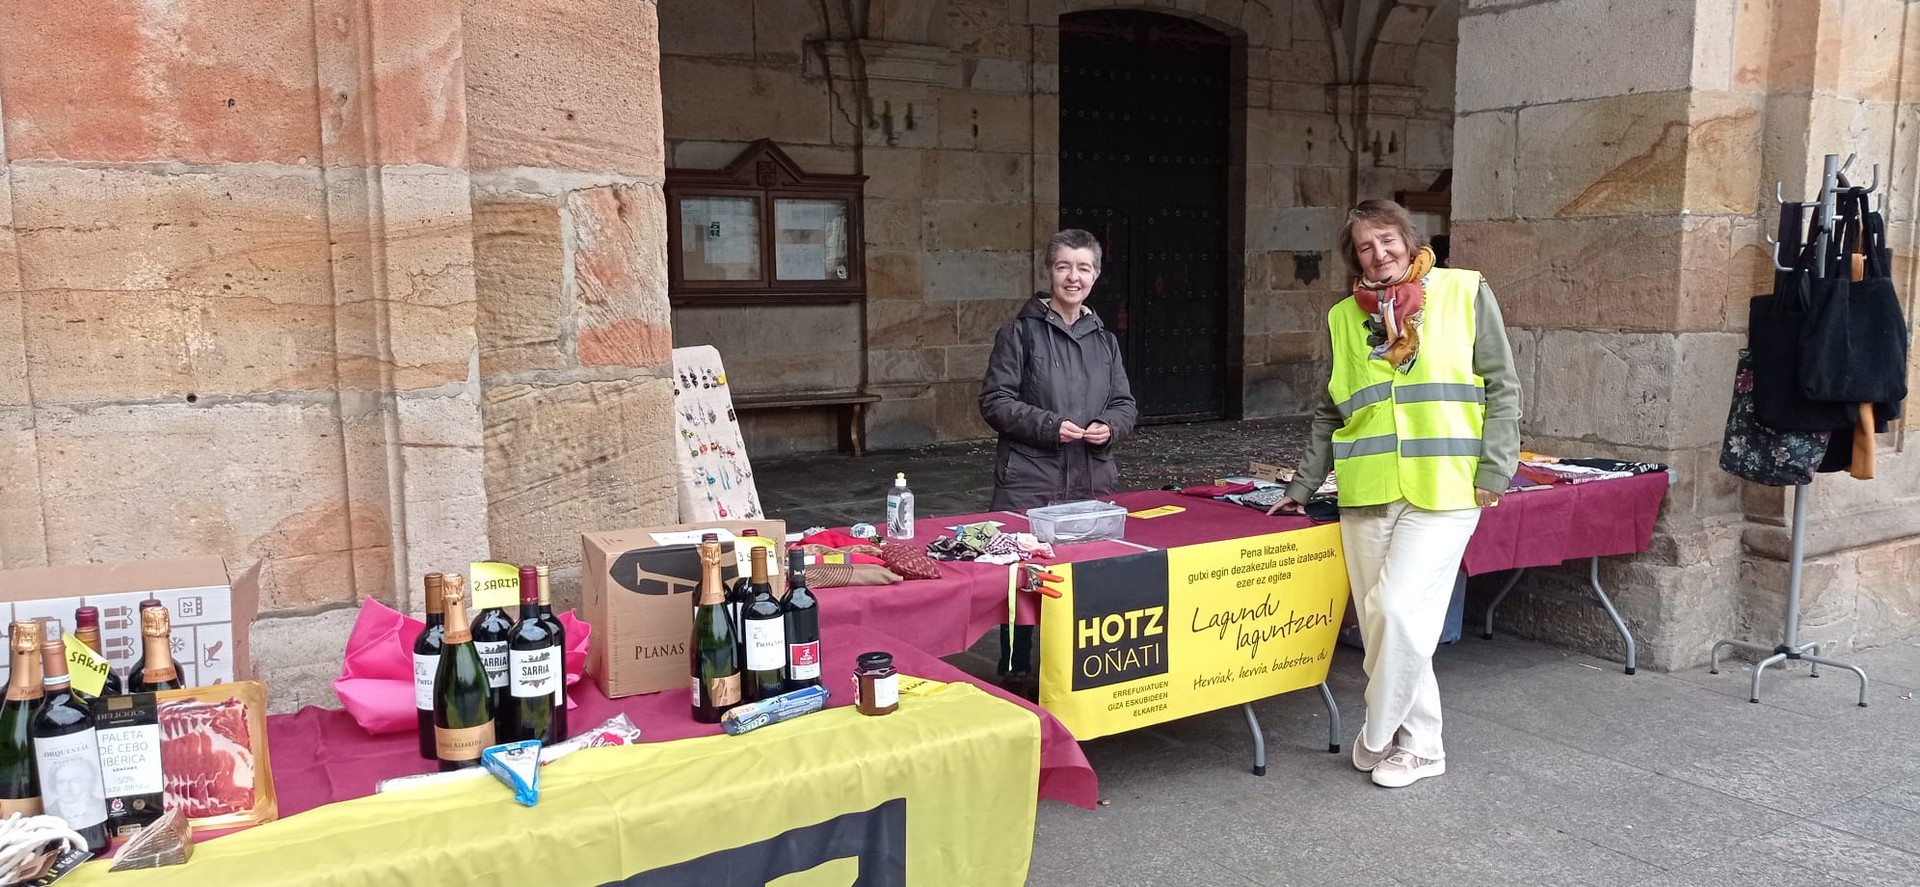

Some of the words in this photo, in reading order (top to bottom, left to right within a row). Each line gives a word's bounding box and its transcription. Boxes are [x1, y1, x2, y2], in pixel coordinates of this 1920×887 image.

[1240, 548, 1262, 559] Pena
[1264, 542, 1298, 556] litzateke,
[1188, 570, 1209, 584] gutxi
[1211, 566, 1229, 580] egin
[1231, 559, 1277, 576] dezakezula
[1279, 555, 1295, 567] uste
[1297, 548, 1337, 564] izateagatik,
[484, 577, 519, 591] SARIA
[1236, 578, 1254, 588] ezer
[1256, 576, 1266, 585] ez
[1268, 571, 1291, 583] egitea
[1192, 593, 1280, 640] Lagundu
[1078, 606, 1164, 649] HOTZ
[1236, 598, 1334, 659] laguntzen!
[635, 642, 685, 660] PLANAS
[69, 651, 108, 676] SARIA
[1083, 643, 1159, 678] OÑATI
[1194, 669, 1235, 690] Herriak,
[1239, 662, 1268, 679] herria
[1272, 652, 1314, 672] babesten
[1317, 648, 1328, 661] du
[1113, 681, 1169, 699] ERREFUXIATUEN
[1107, 701, 1124, 711] GIZA
[1125, 692, 1168, 708] ESKUBIDEEN
[1133, 703, 1168, 717] ELKARTEA
[102, 730, 143, 743] PALETA
[99, 745, 114, 756] DE
[118, 741, 149, 753] CEBO
